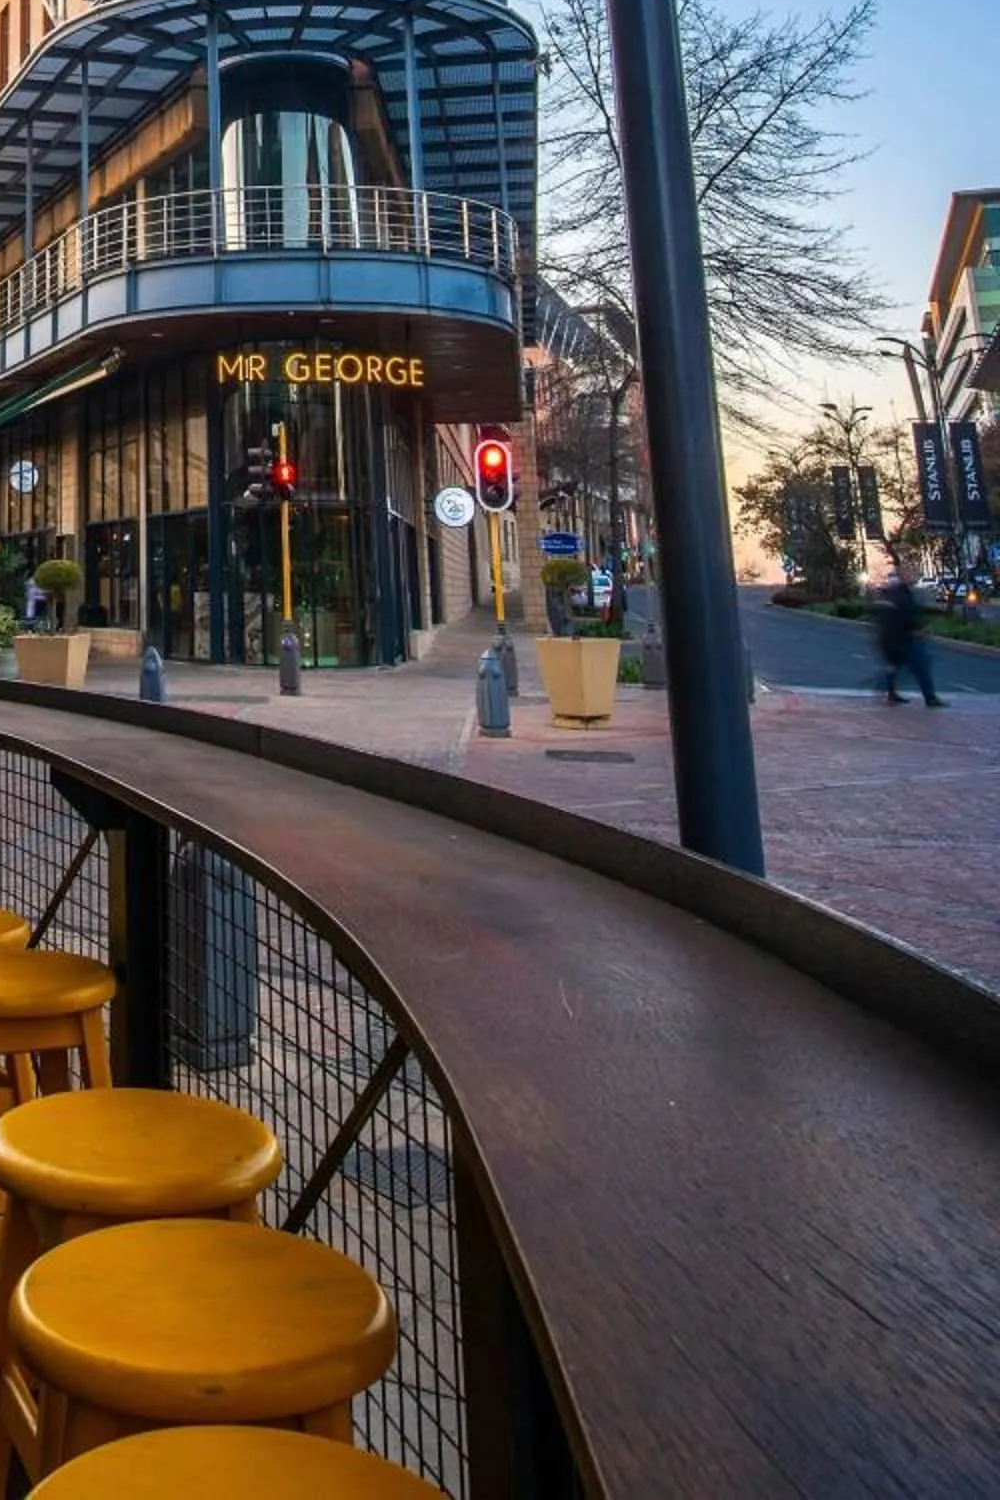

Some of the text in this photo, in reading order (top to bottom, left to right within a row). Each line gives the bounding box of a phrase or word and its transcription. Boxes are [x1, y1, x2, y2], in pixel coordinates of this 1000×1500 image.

[217, 353, 425, 387] MR GEORGE
[923, 439, 941, 501] STANLIB
[960, 439, 981, 501] STANLIB
